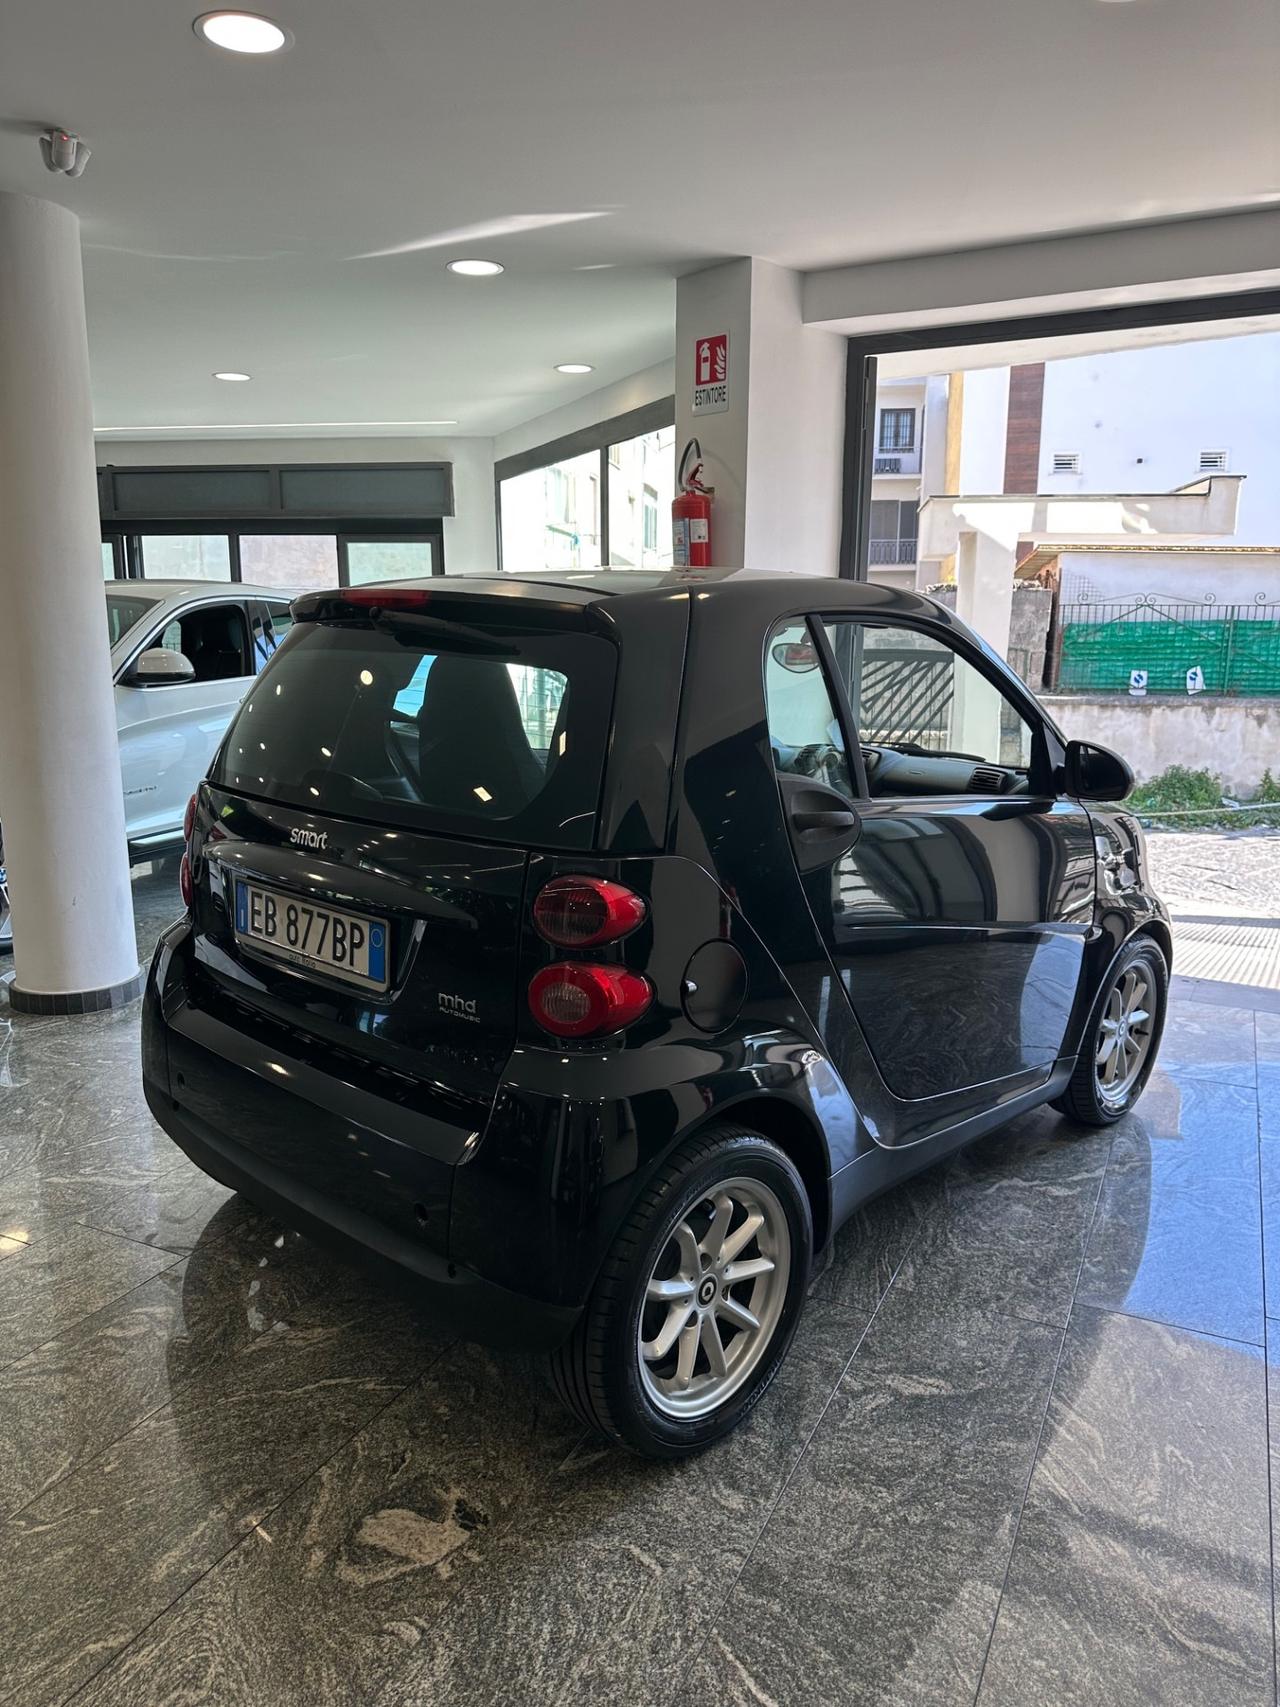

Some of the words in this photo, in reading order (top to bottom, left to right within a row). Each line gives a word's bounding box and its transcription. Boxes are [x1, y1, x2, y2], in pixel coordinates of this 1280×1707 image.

[695, 385, 726, 406] ESTINTORE
[290, 828, 328, 850] smart
[251, 891, 277, 937] EB
[286, 904, 365, 967] 877BP
[438, 993, 476, 1014] mhd
